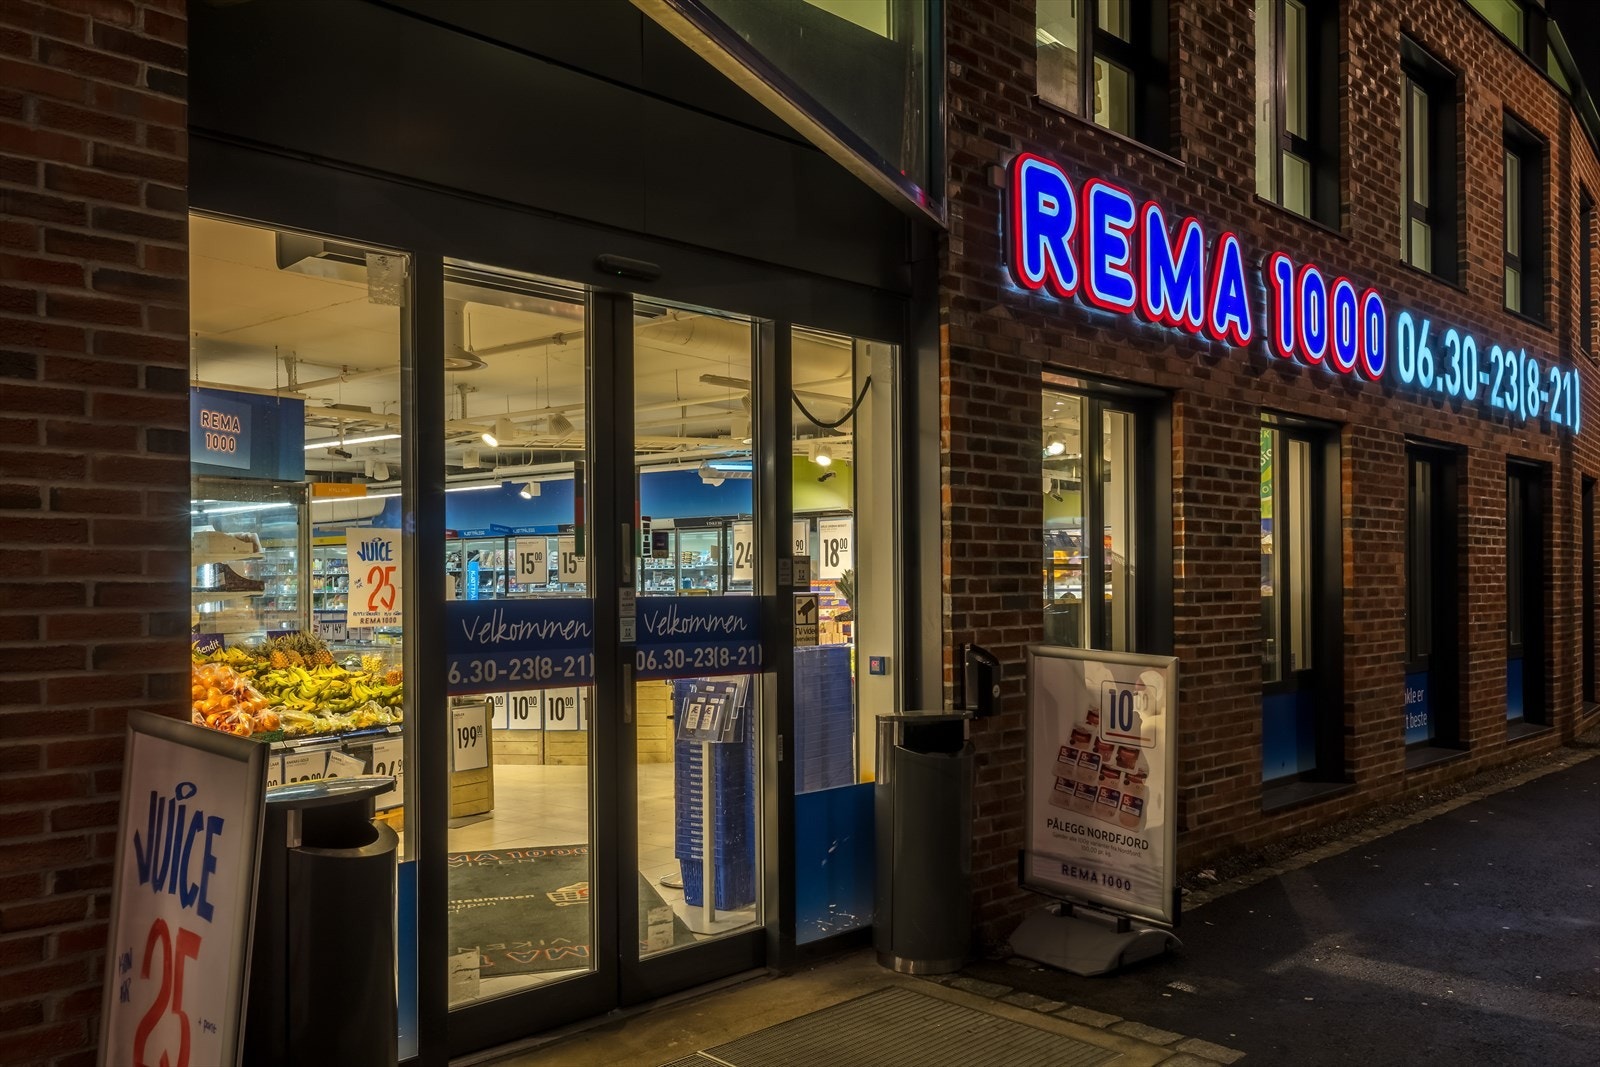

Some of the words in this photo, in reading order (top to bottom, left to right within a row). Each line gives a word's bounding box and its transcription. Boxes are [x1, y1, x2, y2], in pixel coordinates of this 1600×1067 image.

[1011, 152, 1252, 348] REMA
[1264, 251, 1388, 381] 1000
[1398, 311, 1581, 434] 06.30-23(8-21)
[201, 411, 240, 433] REMA
[206, 435, 235, 452] 1000
[357, 538, 393, 562] JUICE
[795, 540, 804, 551] 90
[823, 538, 840, 567] 18
[840, 538, 848, 550] 00
[520, 552, 534, 574] 15
[535, 552, 542, 560] 00
[562, 552, 578, 574] 15
[366, 566, 396, 612] 25
[462, 608, 592, 644] Velkommen
[644, 604, 747, 636] Velkommen
[197, 638, 220, 655] Bendit
[512, 696, 528, 720] 10
[529, 696, 537, 706] 00
[548, 697, 564, 721] 10
[565, 697, 574, 706] 00
[1108, 689, 1134, 732] 10
[1410, 712, 1428, 728] beste
[458, 726, 476, 749] 199
[1047, 817, 1084, 836] PÅLEGG
[1087, 828, 1149, 850] NORDFJORD
[133, 781, 224, 924] JUICE
[1062, 864, 1098, 884] REMA
[1102, 874, 1131, 891] 1000
[133, 917, 203, 1067] 25
